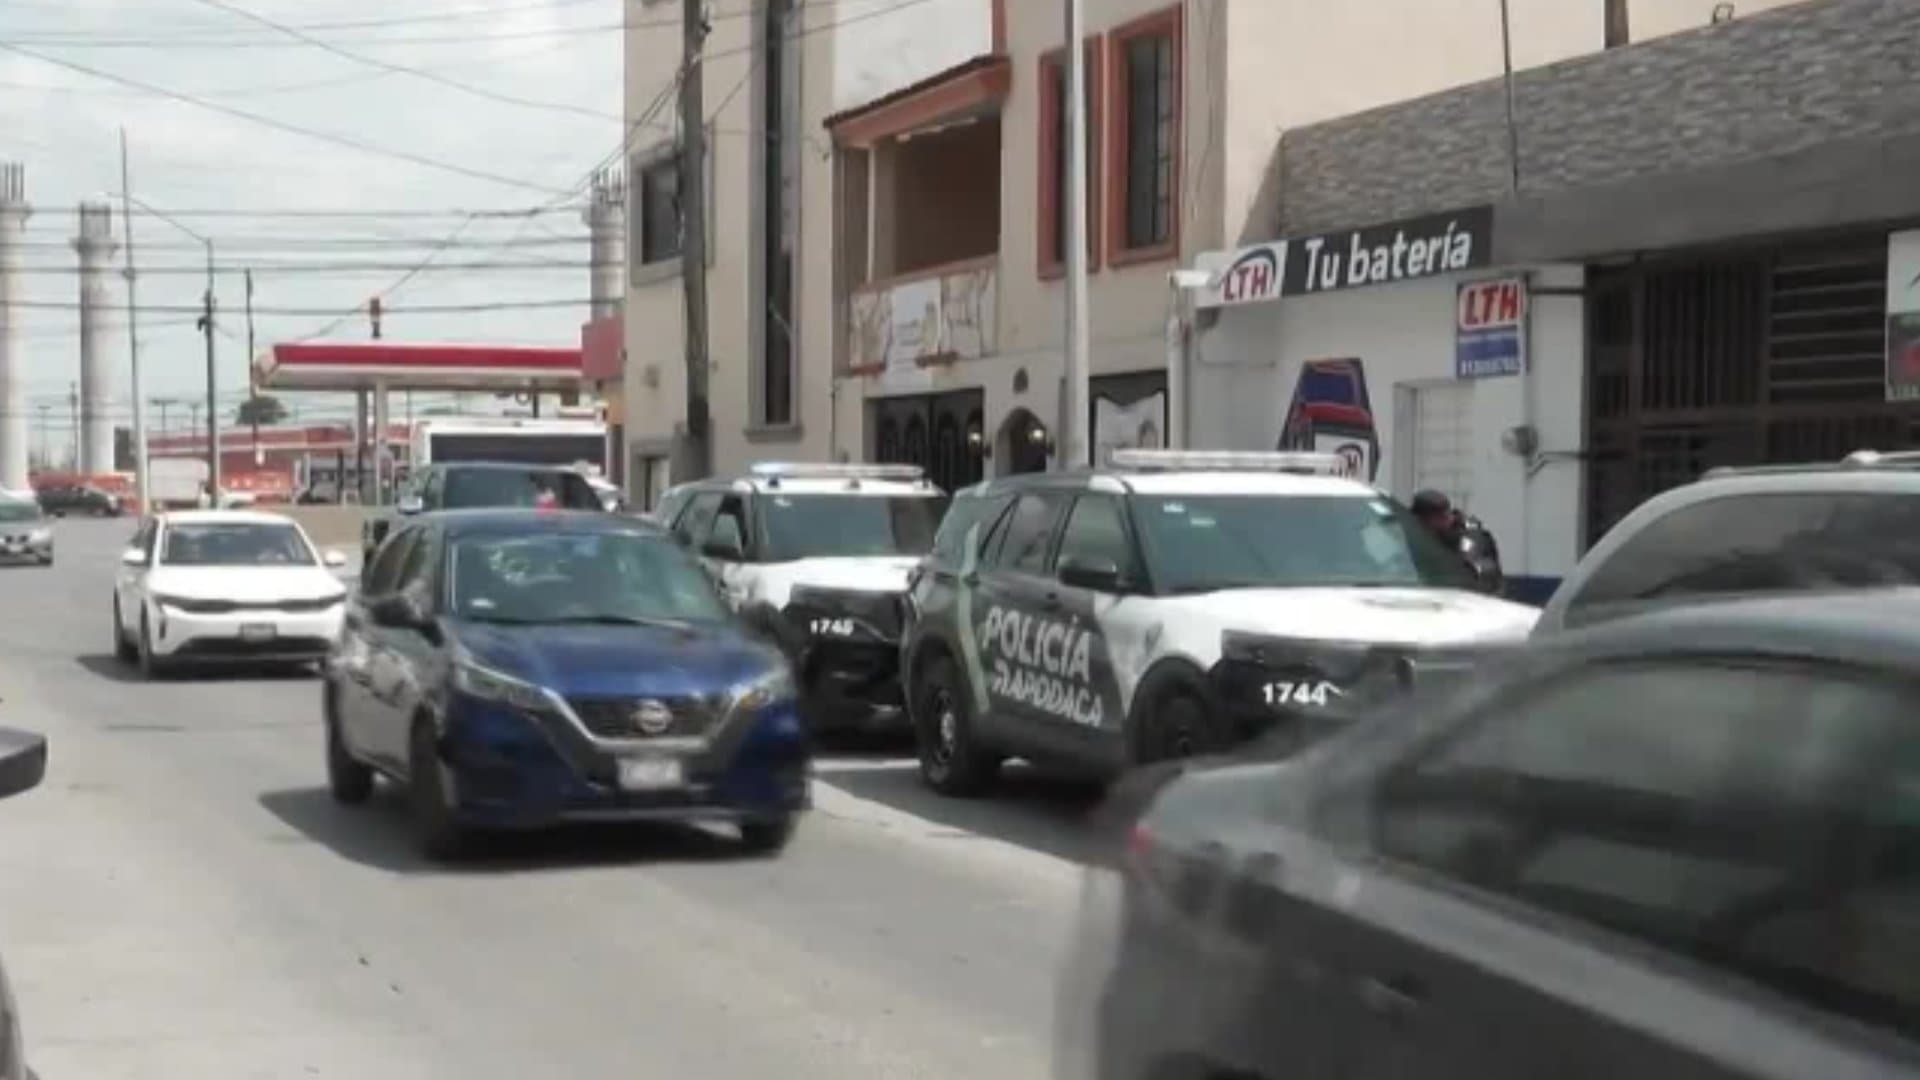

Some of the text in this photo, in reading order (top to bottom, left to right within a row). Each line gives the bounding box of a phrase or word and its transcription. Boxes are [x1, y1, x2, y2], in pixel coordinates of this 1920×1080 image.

[1304, 219, 1472, 291] Tu batería
[1223, 262, 1270, 301] LTH
[1464, 283, 1519, 325] LTH
[982, 604, 1091, 683] POLICÍA
[1262, 681, 1328, 706] 1744
